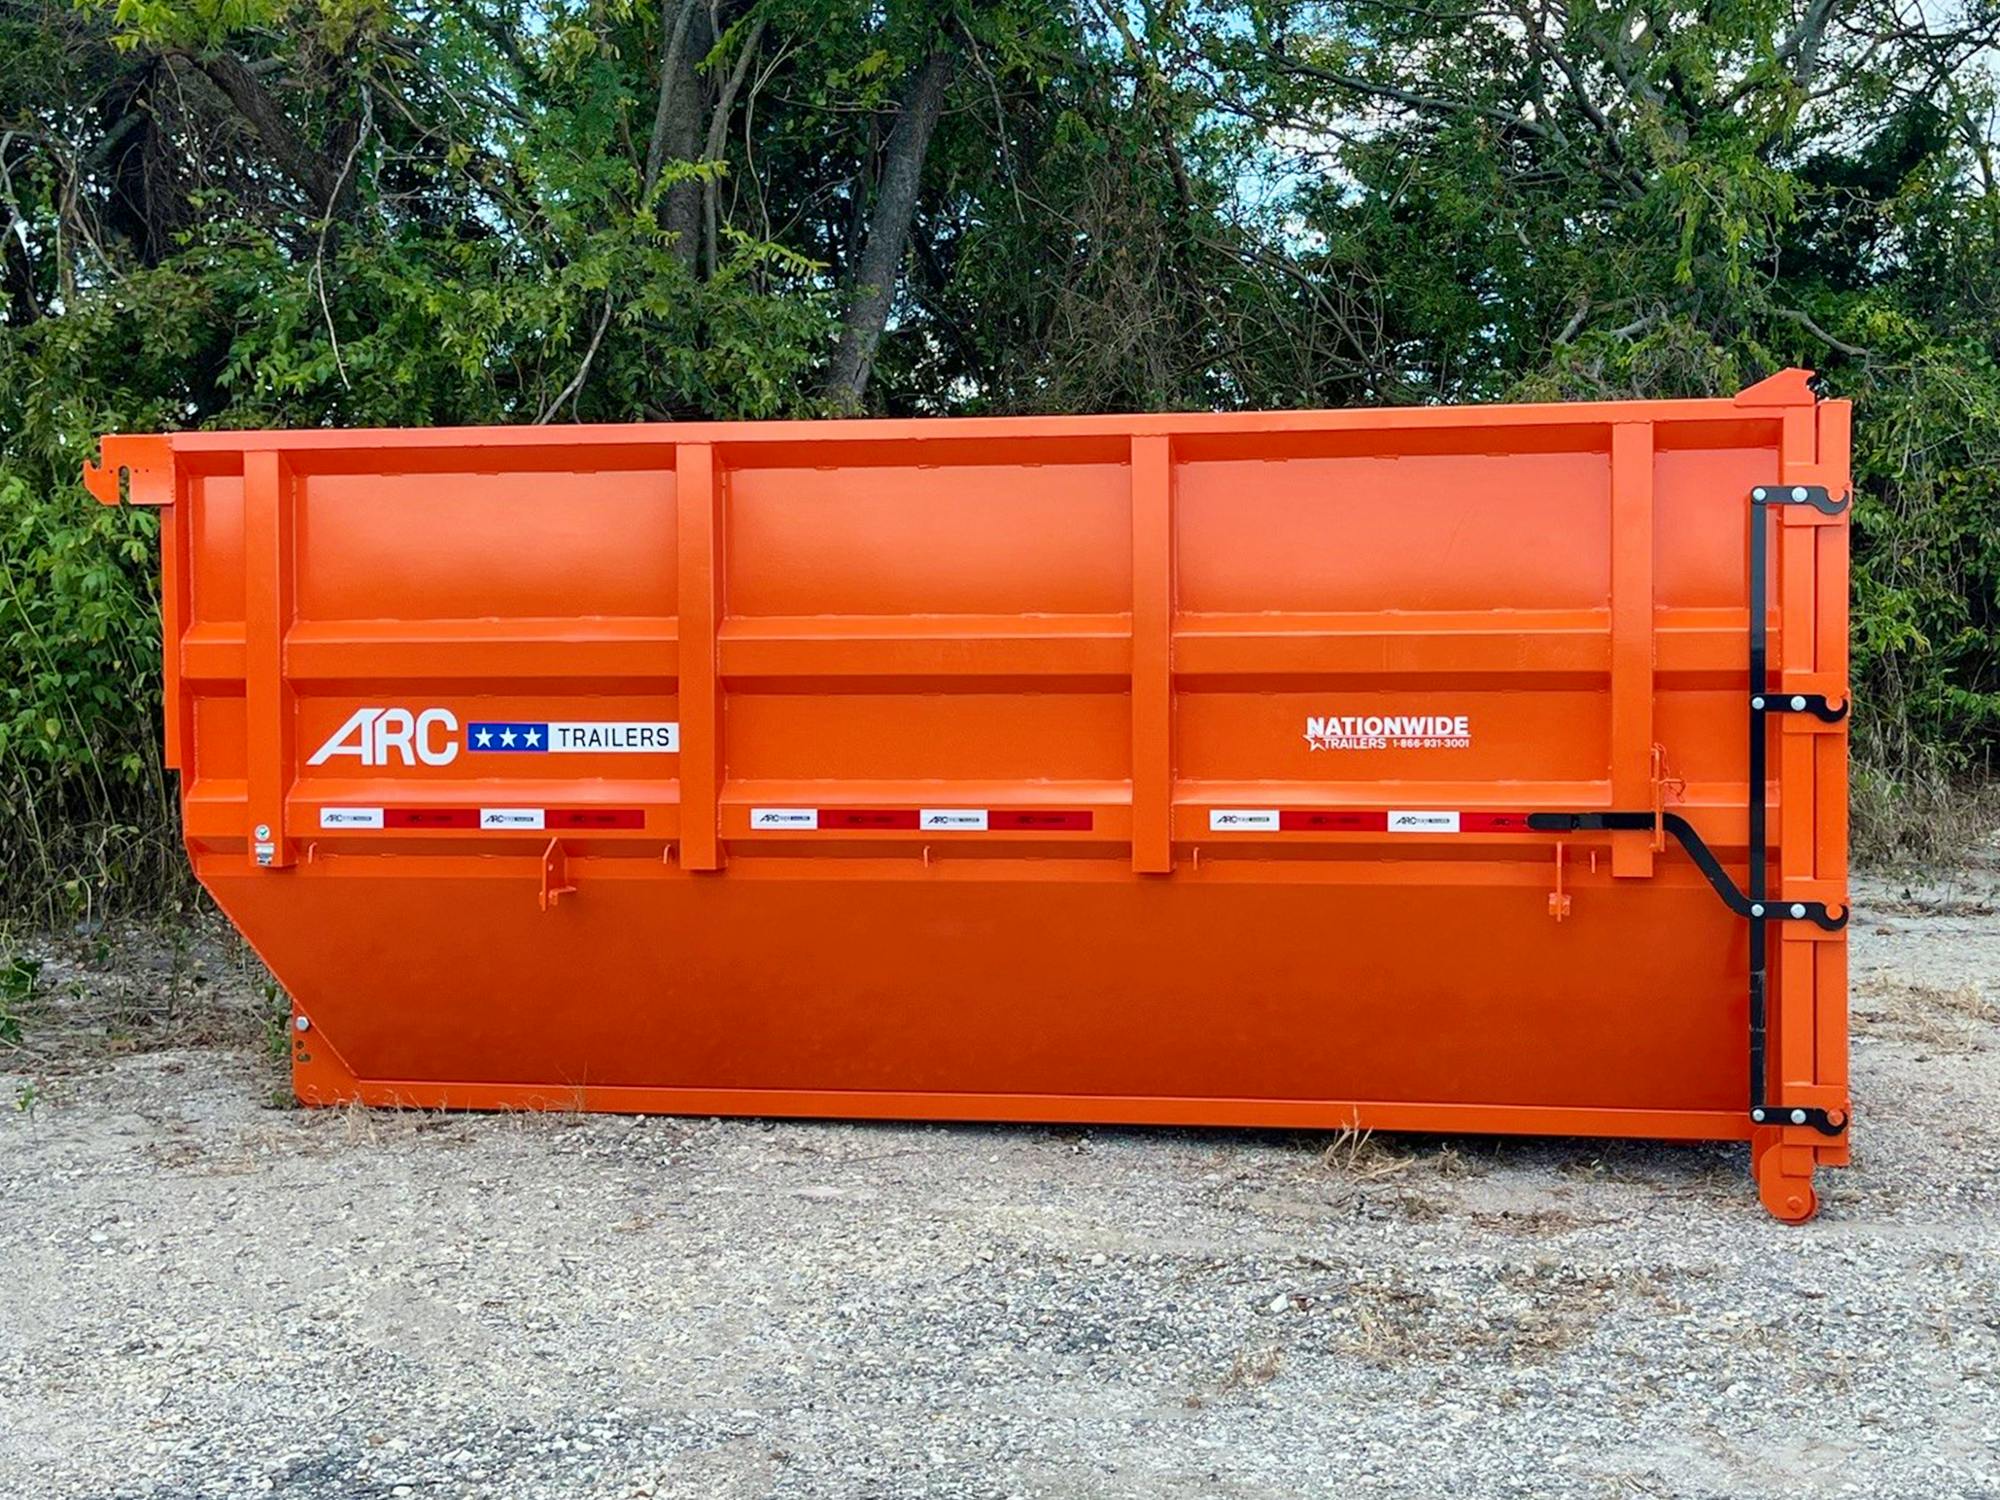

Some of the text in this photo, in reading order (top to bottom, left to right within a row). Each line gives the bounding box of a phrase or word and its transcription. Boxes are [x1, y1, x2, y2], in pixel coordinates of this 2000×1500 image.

[1306, 716, 1469, 736] NATIONWIDE
[306, 708, 670, 766] ARC TRAILERS
[1323, 735, 1469, 749] TRAILERS 1-866-931-3001
[324, 814, 342, 823] ARC
[484, 814, 504, 823] ARC
[759, 814, 780, 823] ARC
[928, 815, 949, 824] ARC
[1217, 815, 1238, 824] ARC
[1395, 816, 1416, 825] ARC
